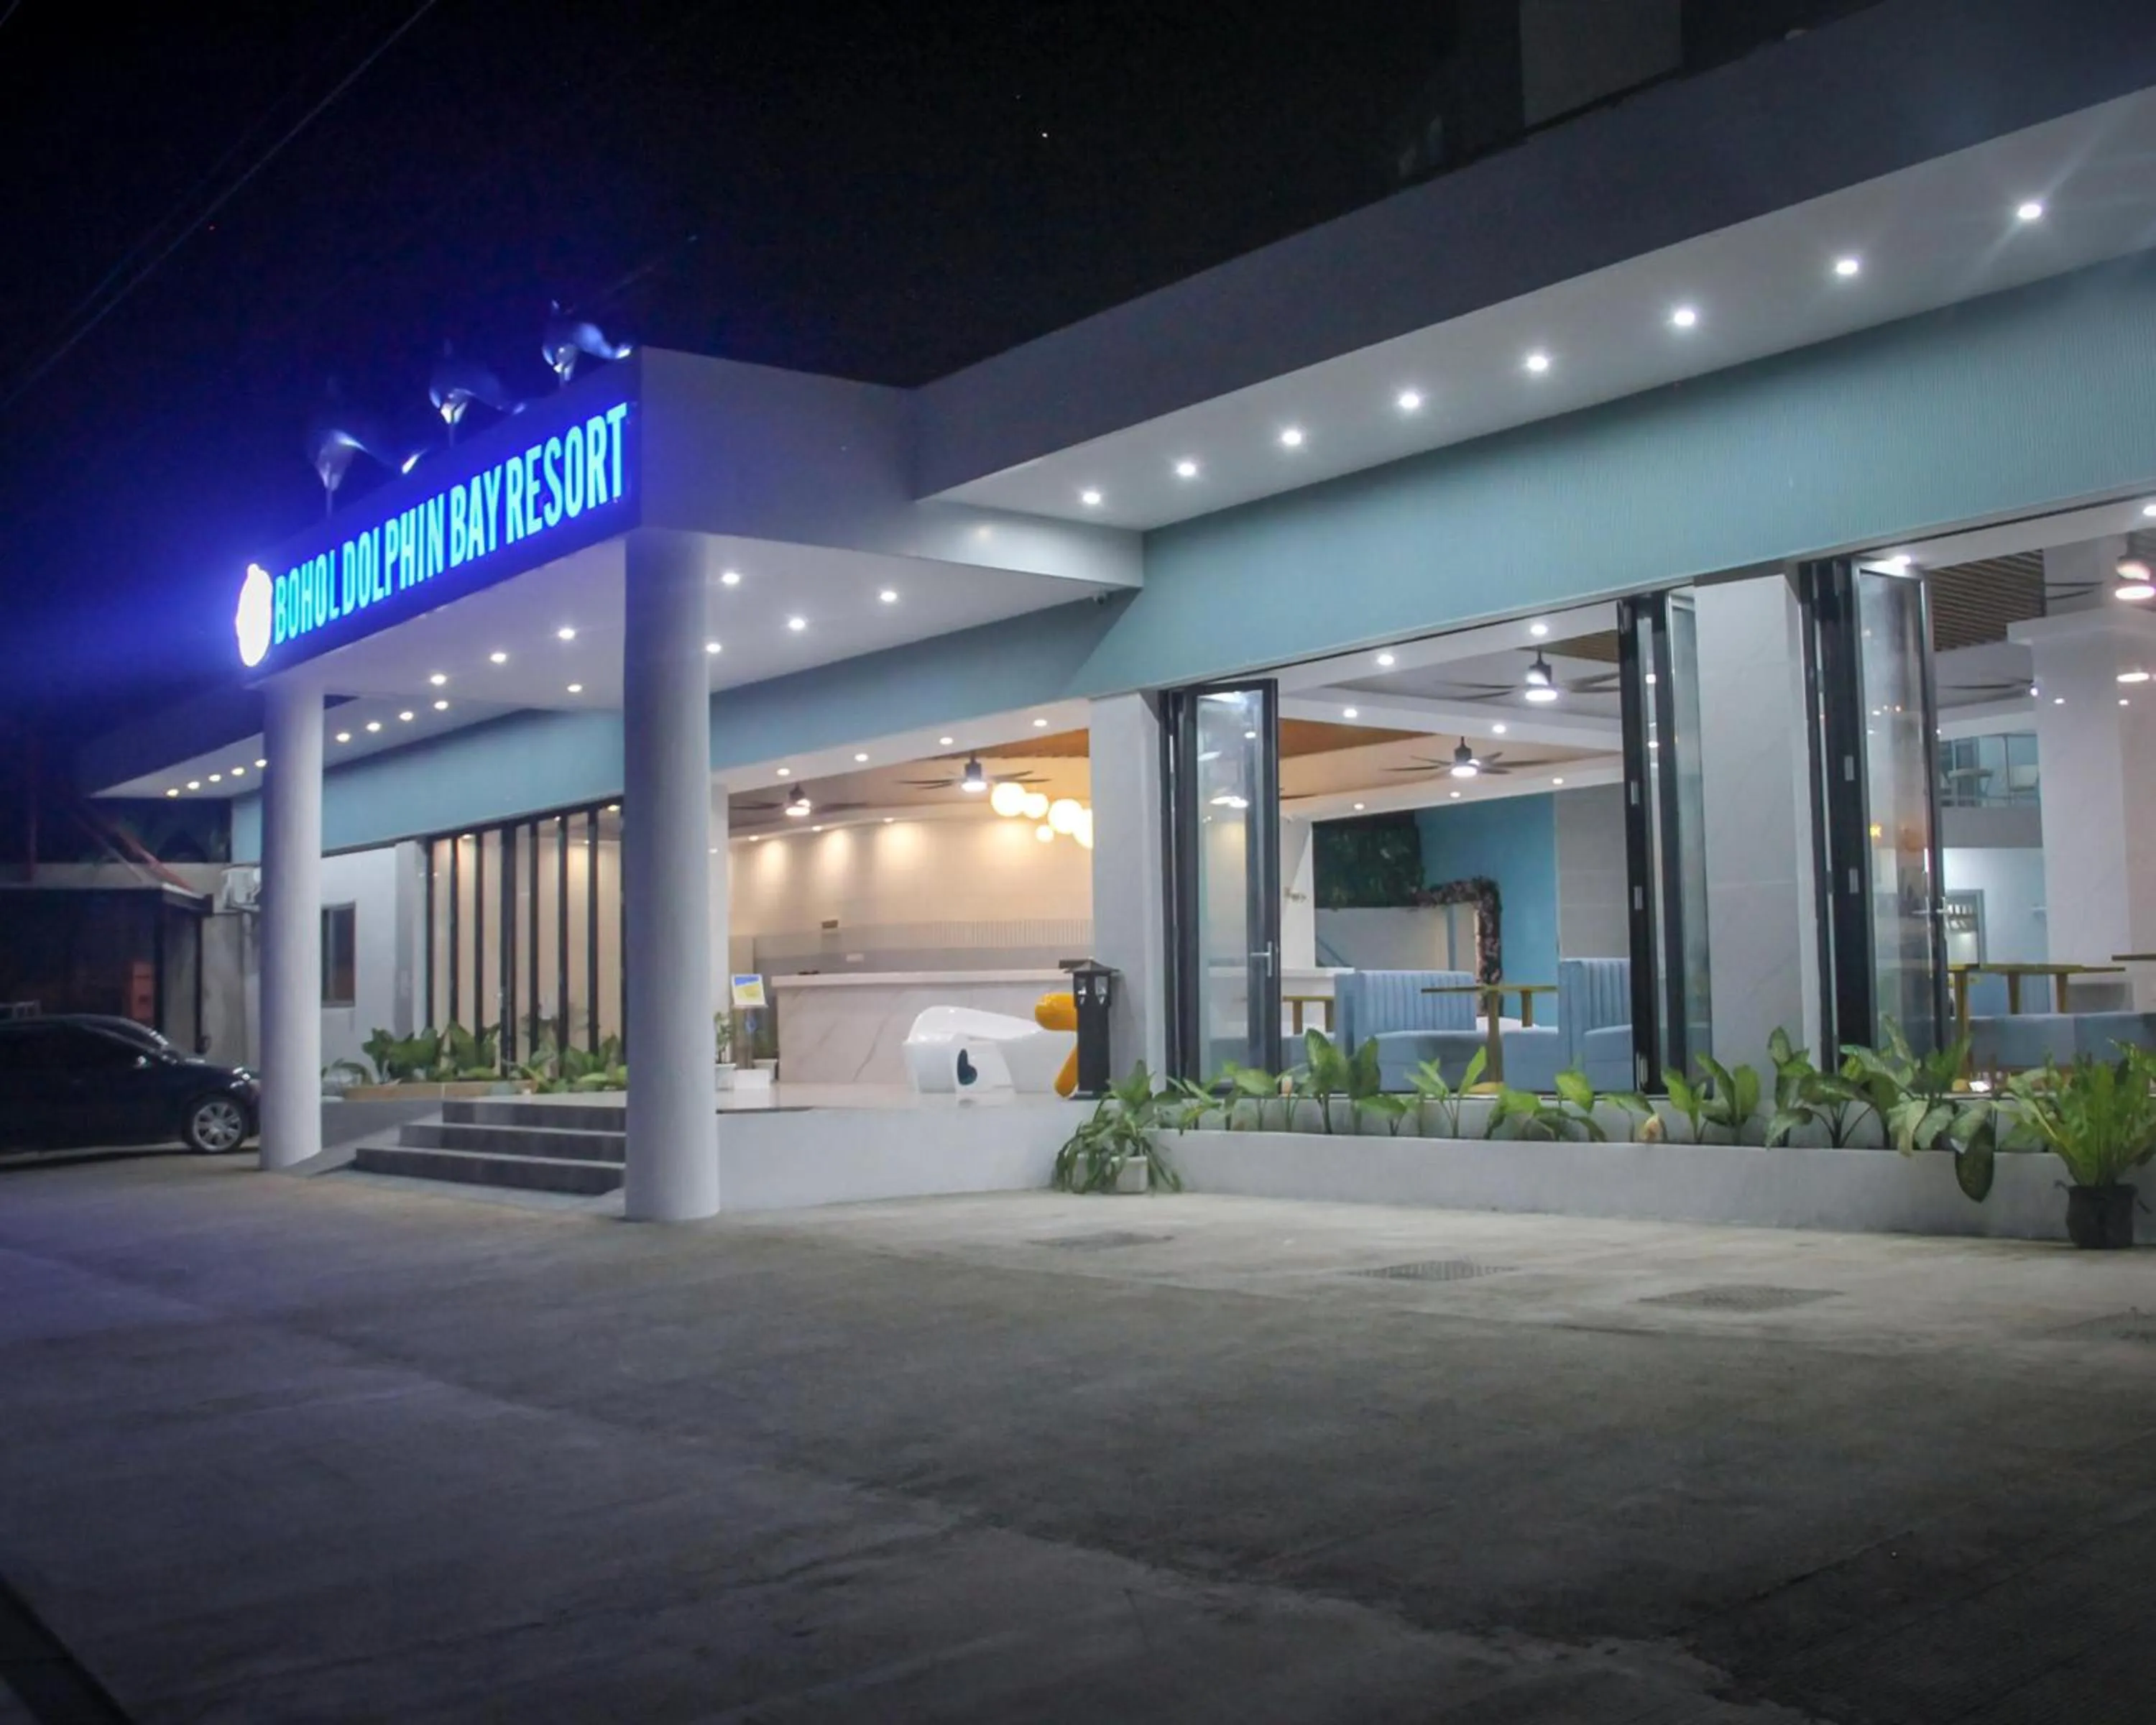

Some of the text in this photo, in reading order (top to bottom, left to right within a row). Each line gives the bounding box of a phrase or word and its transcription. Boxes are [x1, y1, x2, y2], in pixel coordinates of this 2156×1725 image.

[274, 403, 627, 644] BOHOL DOLPHIN BAY RESORT
